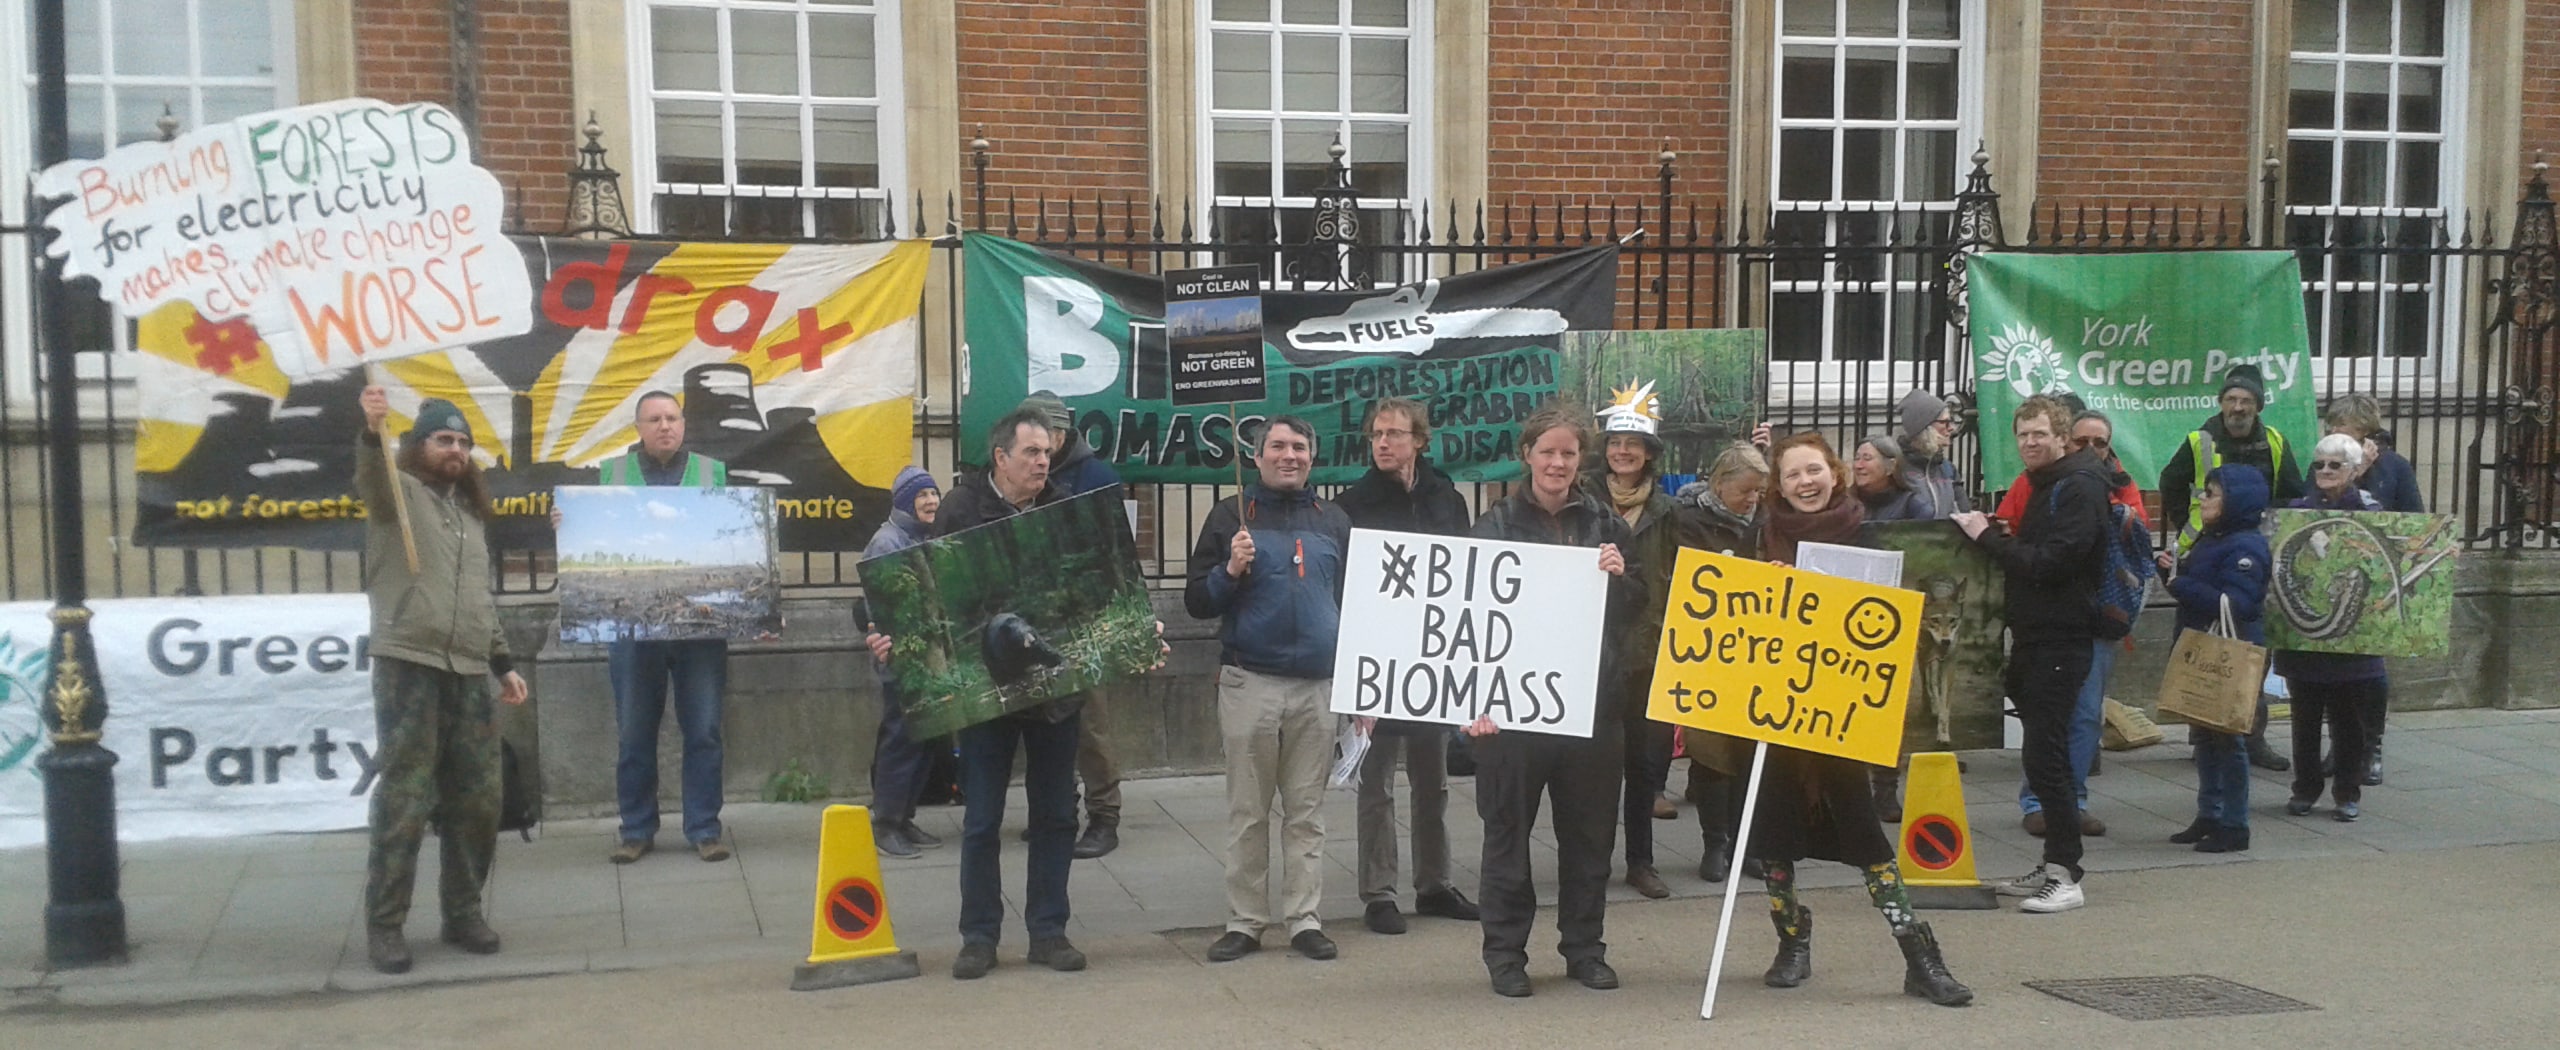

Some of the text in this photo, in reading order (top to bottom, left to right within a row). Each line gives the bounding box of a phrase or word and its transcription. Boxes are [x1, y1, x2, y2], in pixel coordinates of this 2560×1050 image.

[78, 104, 457, 223] Burning FORESTS
[93, 170, 428, 268] for electricity
[122, 243, 229, 304] makes
[206, 203, 476, 315] climate change
[1177, 280, 1250, 295] NOT CLEAN
[288, 244, 501, 365] WORSE
[541, 243, 854, 373] drax
[1349, 315, 1435, 344] FUELS
[2081, 314, 2153, 347] York
[1175, 382, 1191, 391] END
[1192, 377, 1240, 389] GREENWASH
[1181, 357, 1255, 373] NOT GREEN
[1289, 353, 1554, 406] DEFORESTATION
[2077, 351, 2192, 386] Green
[2087, 391, 2110, 410] for
[2111, 392, 2140, 411] the
[175, 494, 231, 519] not
[242, 493, 368, 520] forests
[1379, 540, 1522, 604] #BIG
[1684, 564, 1820, 625] Smile
[1421, 603, 1513, 664] BAD
[1356, 656, 1565, 725] BIOMASS
[1788, 640, 1897, 708] going
[1668, 681, 1857, 742] to Win!
